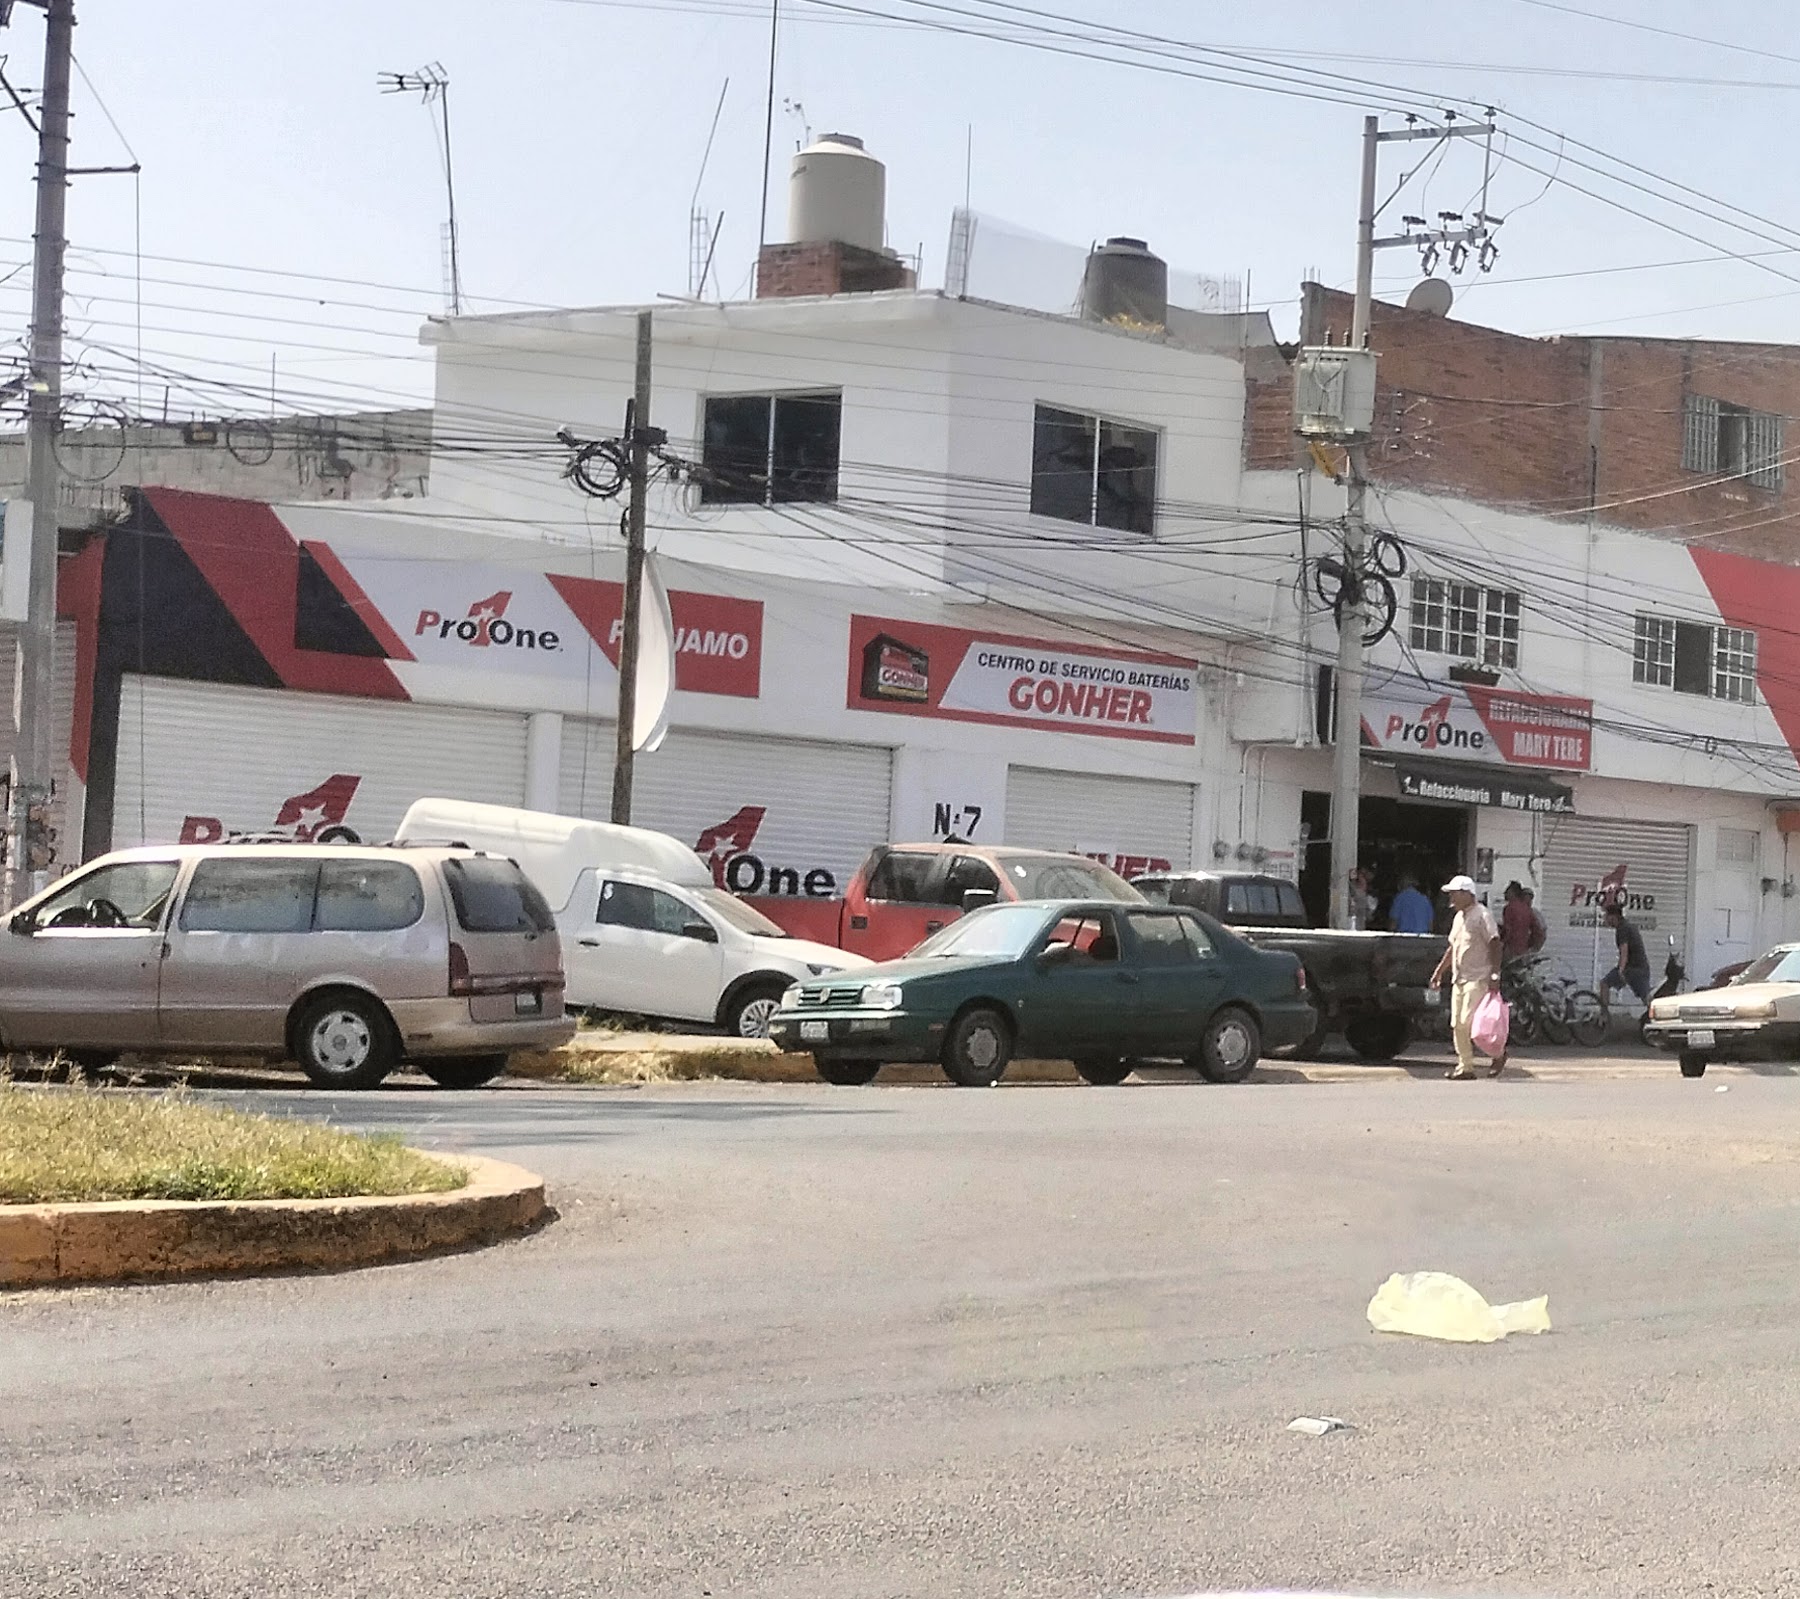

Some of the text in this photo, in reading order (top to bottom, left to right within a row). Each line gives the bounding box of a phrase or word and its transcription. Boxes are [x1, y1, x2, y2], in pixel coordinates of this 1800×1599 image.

[608, 619, 750, 660] PJAMO
[978, 651, 1190, 691] CENTRO DE SERVICIO BATERÍAS
[1008, 676, 1154, 724] GONHER
[1513, 731, 1584, 762] MARY TERE
